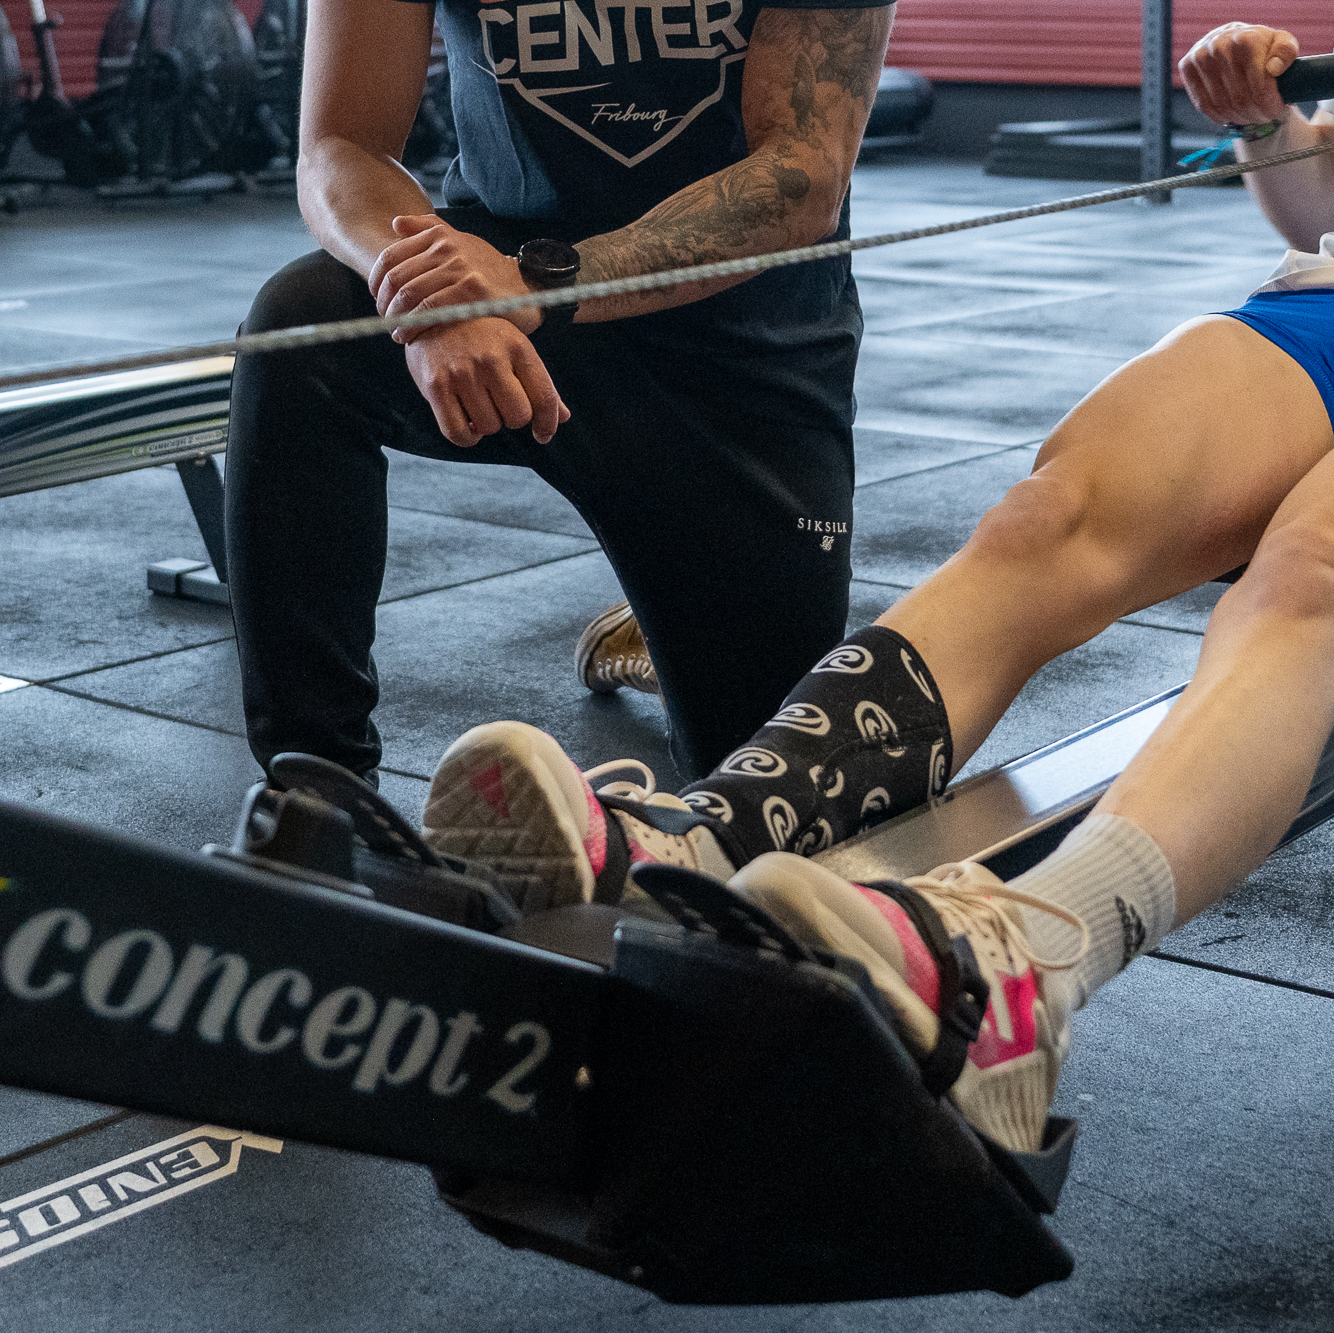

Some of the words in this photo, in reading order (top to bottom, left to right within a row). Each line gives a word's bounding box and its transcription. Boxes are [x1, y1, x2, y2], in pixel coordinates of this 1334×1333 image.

[591, 102, 679, 131] Fribourg
[797, 517, 848, 534] SIKSILK
[1, 907, 483, 1096] concept
[487, 1020, 552, 1113] 2
